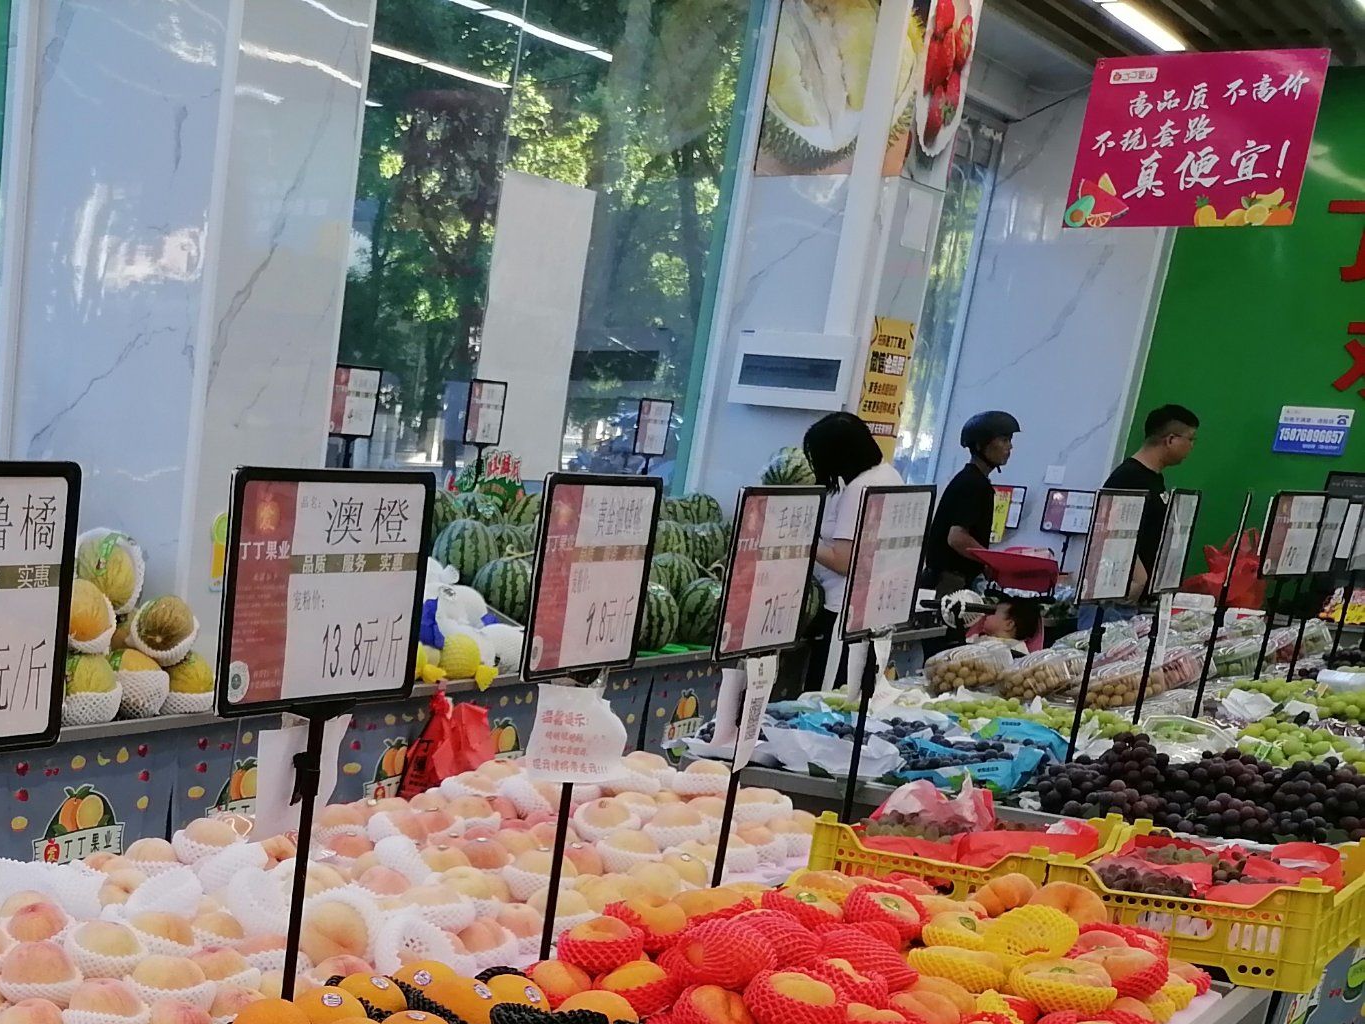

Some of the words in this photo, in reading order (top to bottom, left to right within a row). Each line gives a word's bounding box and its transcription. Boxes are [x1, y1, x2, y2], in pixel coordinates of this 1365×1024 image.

[1129, 82, 1210, 118] 高品质
[1222, 70, 1311, 106] 不高价
[1091, 114, 1216, 157] 不玩套路
[325, 496, 410, 546] 澳橙
[240, 541, 292, 561] 丁丁果业
[17, 563, 51, 589] 实惠
[321, 613, 404, 682] 13.8元/斤
[64, 829, 114, 860] 丁丁果业
